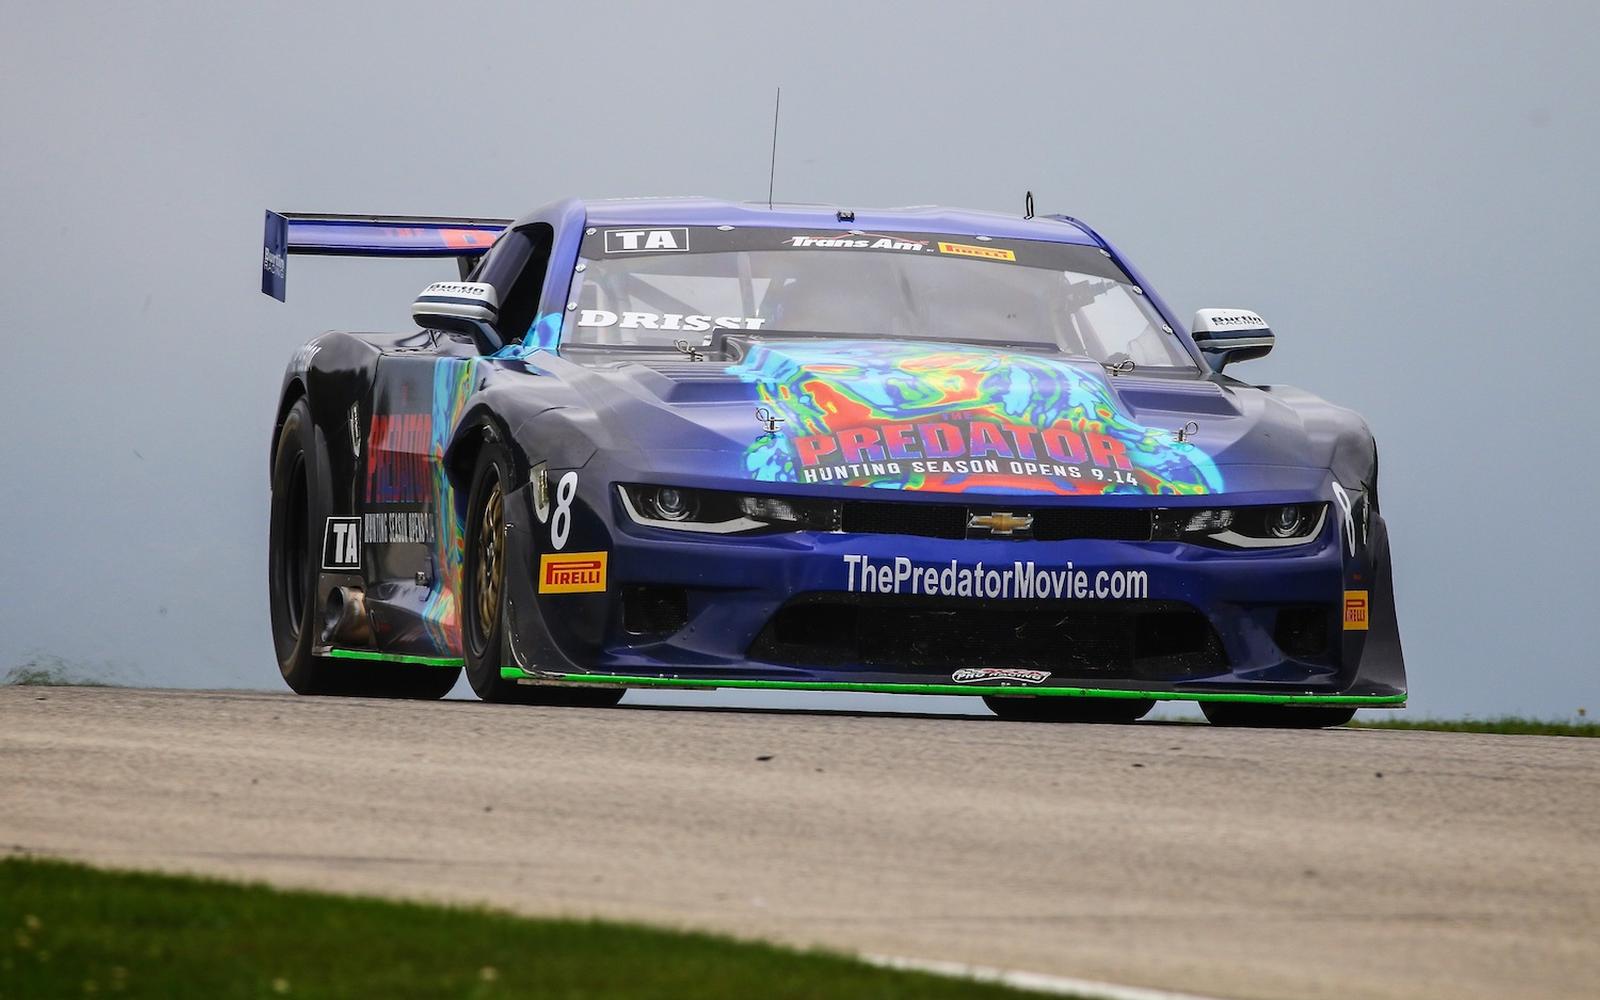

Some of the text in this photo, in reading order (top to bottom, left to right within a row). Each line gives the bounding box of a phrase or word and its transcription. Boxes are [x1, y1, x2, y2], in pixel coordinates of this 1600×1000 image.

[615, 230, 679, 250] TA
[791, 236, 922, 251] Trans Am
[794, 421, 1134, 471] PREDATOR
[803, 459, 1139, 487] HUNTING SEASON OPENS 9.14
[551, 471, 578, 550] 8
[1331, 481, 1356, 558] 8
[333, 523, 358, 563] TA
[546, 560, 602, 585] PIRELLI
[843, 554, 1148, 599] ThePredatorMovie.com
[1344, 599, 1367, 622] PIRELLI
